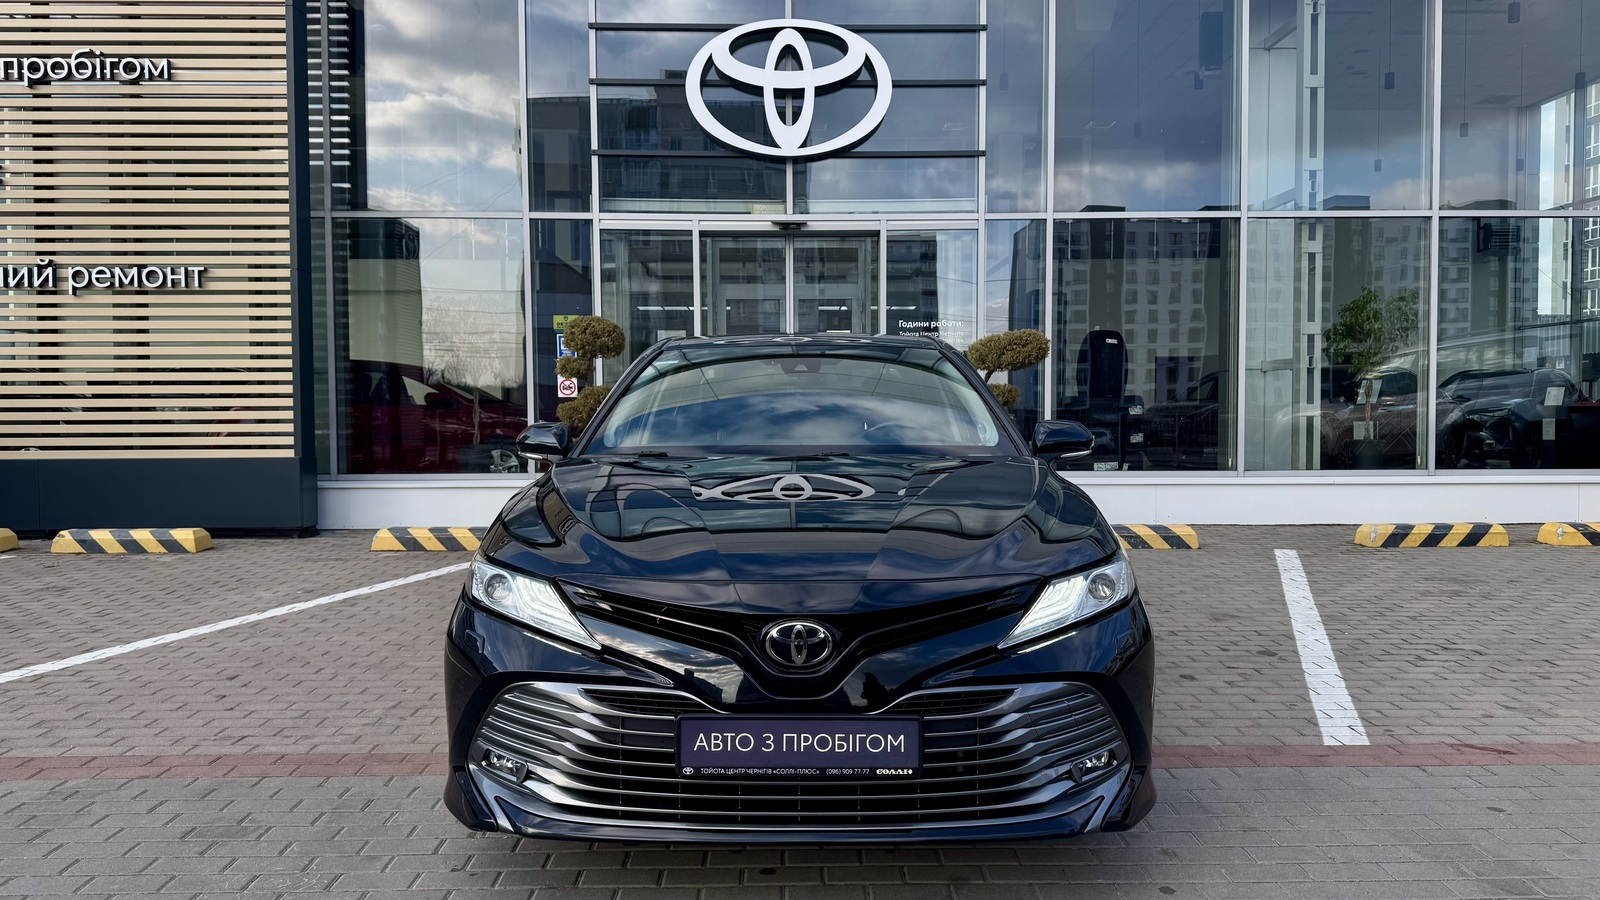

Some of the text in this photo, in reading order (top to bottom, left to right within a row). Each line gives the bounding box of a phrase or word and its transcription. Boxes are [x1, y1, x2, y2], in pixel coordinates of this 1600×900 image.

[0, 48, 170, 87] пробігом
[0, 258, 205, 295] ий ремонт
[898, 320, 964, 329] Години роботи:
[693, 733, 754, 751] АВТО
[783, 733, 905, 753] ПРОБІГОМ
[701, 767, 725, 775] ТОЙОТА
